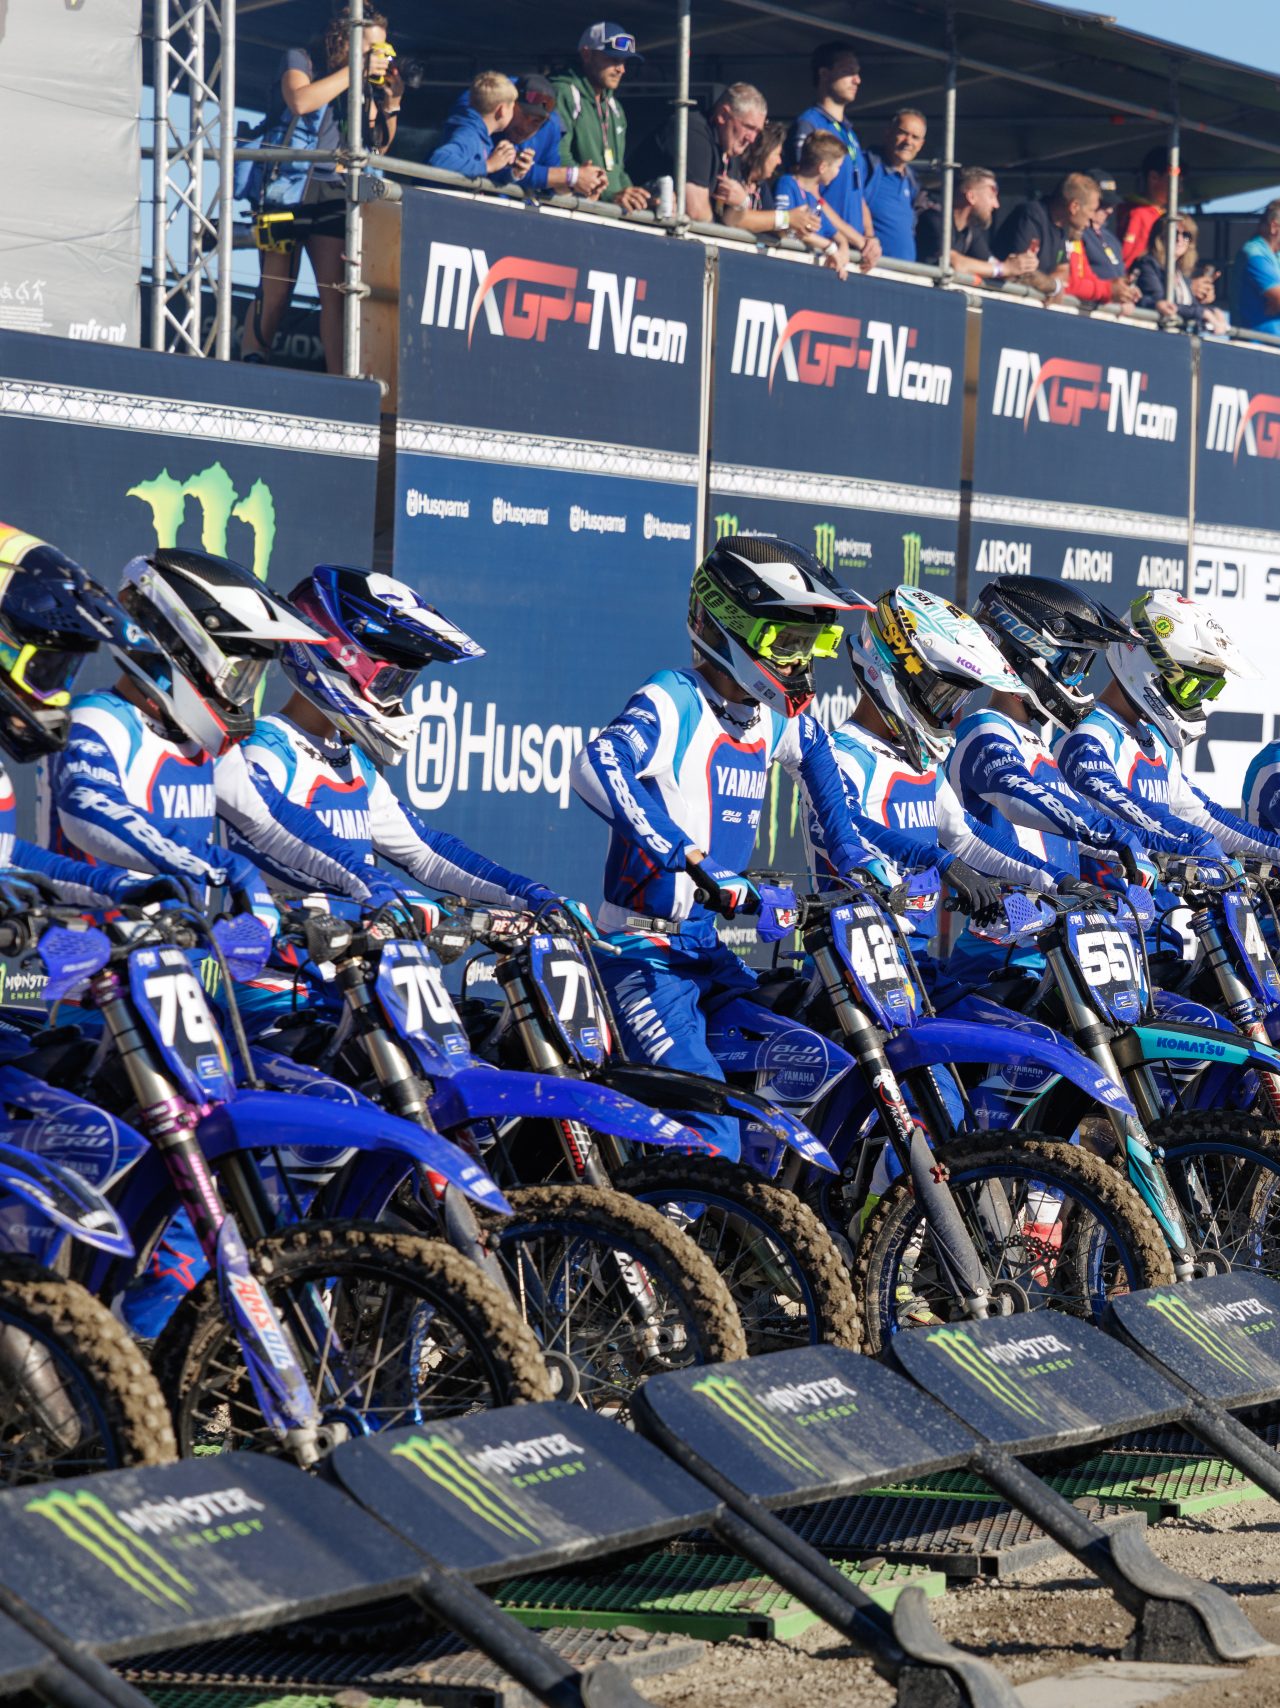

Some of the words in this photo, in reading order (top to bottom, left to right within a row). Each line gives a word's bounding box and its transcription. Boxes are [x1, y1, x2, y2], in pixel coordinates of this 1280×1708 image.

[417, 491, 469, 517] Husqvarna
[502, 499, 548, 526] Husqvarna
[579, 507, 626, 533] Husqvarna
[653, 514, 691, 539] Husqvarna
[976, 540, 1031, 575] AIROH
[1062, 547, 1112, 583] AIROH
[1137, 554, 1184, 590] AIROH
[458, 701, 600, 809] Husqv
[715, 765, 767, 800] YAMAH
[158, 784, 216, 819] YAMA
[892, 800, 937, 829] YAMA
[316, 809, 371, 840] YAMAH
[850, 924, 907, 985] 42
[144, 972, 213, 1048] 78
[390, 964, 462, 1034] 70
[771, 1044, 821, 1054] BLU
[772, 1053, 823, 1064] CRU
[1156, 1037, 1226, 1057] KOMATSU
[784, 1070, 816, 1083] YAMAHA
[1195, 1297, 1269, 1326] MONSTER
[982, 1333, 1072, 1366] MONSTER
[756, 1377, 857, 1413] MONSTER
[465, 1433, 584, 1474] MONSTER
[117, 1487, 264, 1535] MONSTER
